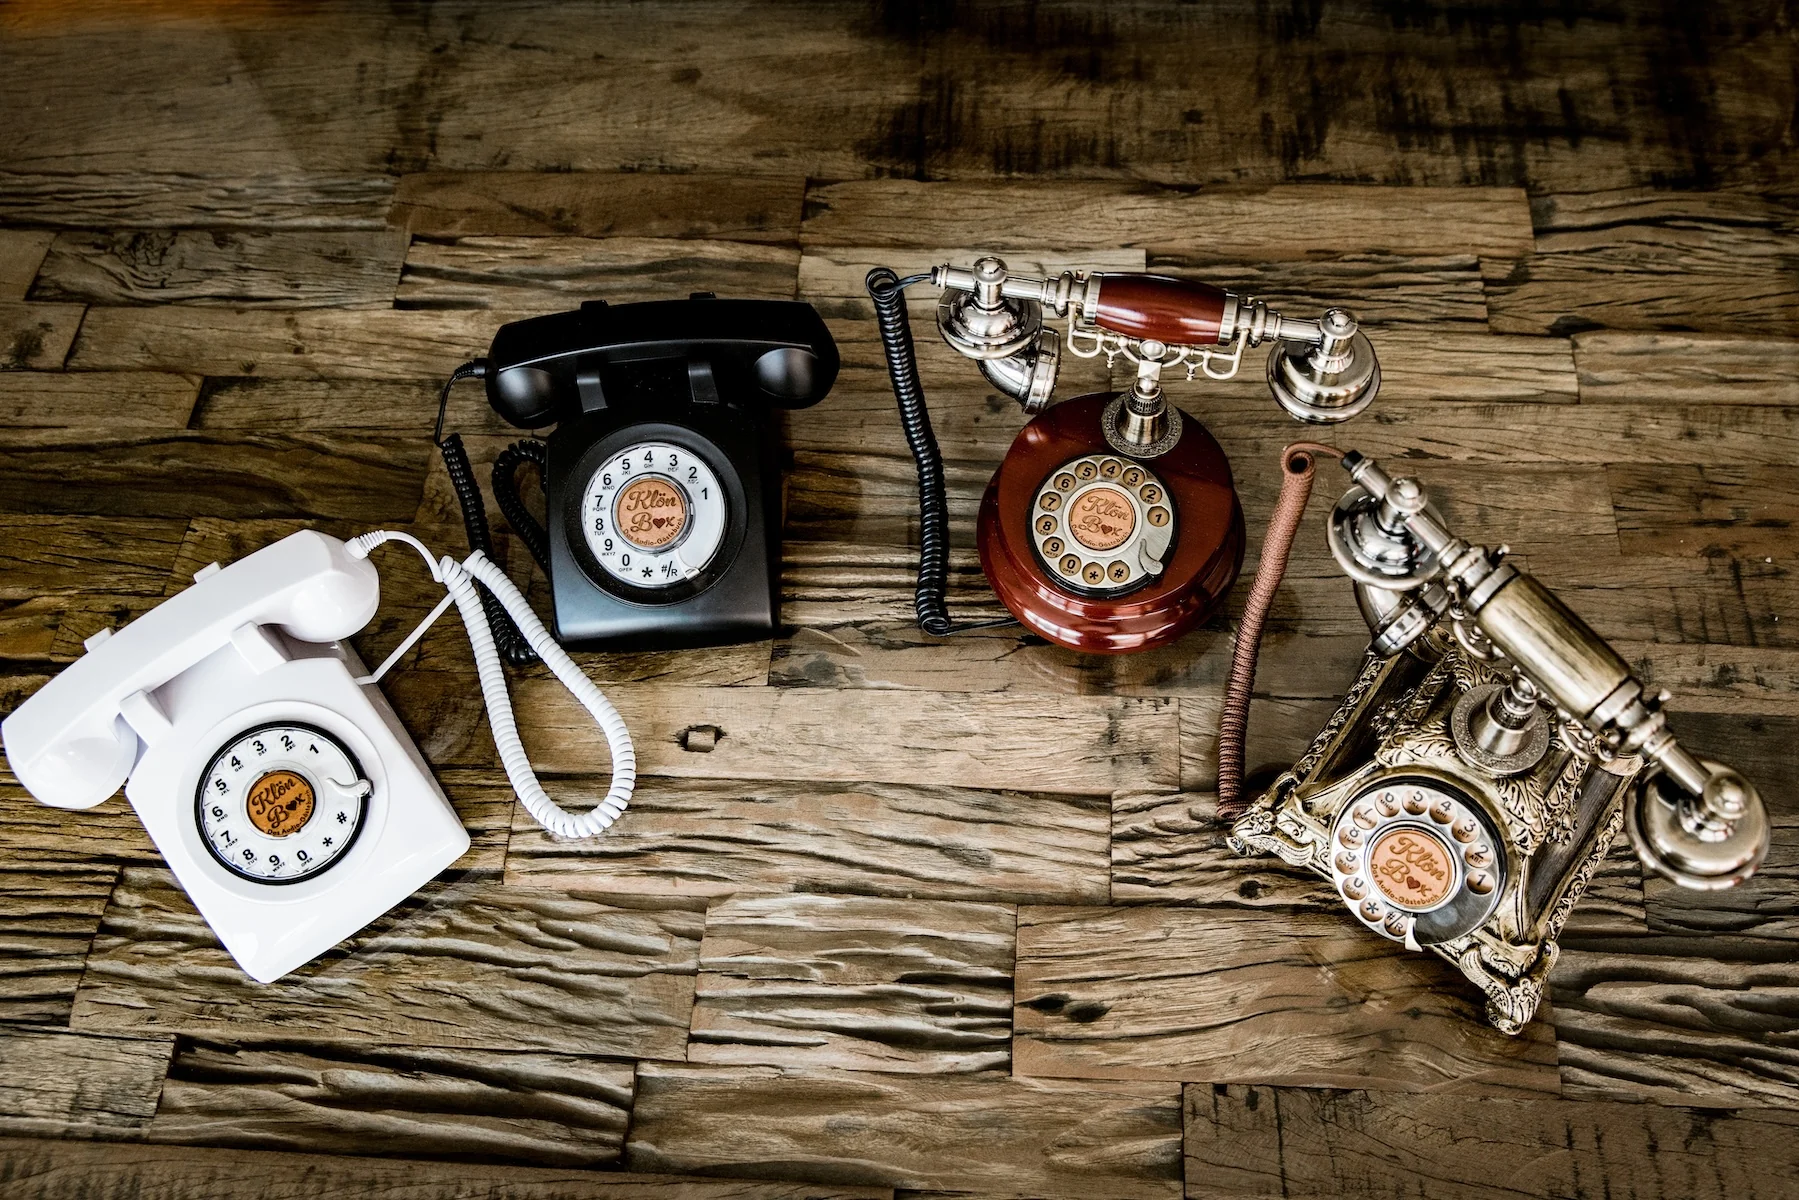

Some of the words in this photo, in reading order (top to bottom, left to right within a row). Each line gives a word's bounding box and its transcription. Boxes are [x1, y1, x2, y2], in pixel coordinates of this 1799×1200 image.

[644, 450, 653, 463] 4
[670, 454, 678, 466] 3
[622, 458, 630, 470] 5
[1106, 466, 1116, 474] 4
[688, 466, 698, 478] 2
[1082, 467, 1092, 476] 5
[1130, 472, 1138, 482] 3
[603, 474, 612, 486] 6
[1062, 478, 1070, 488] 6
[702, 487, 708, 500] 1
[1146, 490, 1156, 500] 2
[595, 495, 603, 506] 7
[626, 490, 676, 511] Klön
[1048, 497, 1056, 506] 7
[596, 518, 604, 530] 8
[1156, 514, 1162, 523] 1
[1042, 521, 1052, 530] 8
[604, 538, 612, 551] 9
[1050, 542, 1060, 552] 9
[622, 554, 630, 566] 0
[1067, 560, 1076, 570] 0
[1114, 568, 1124, 578] #
[252, 740, 264, 752] 3
[280, 735, 292, 748] 2
[310, 744, 319, 754] 1
[231, 756, 241, 767] 4
[215, 778, 226, 791] 5
[252, 778, 296, 815] Klön
[212, 806, 223, 818] 6
[1440, 800, 1452, 812] 4
[336, 812, 347, 824] #
[1464, 819, 1476, 832] 3
[220, 830, 230, 842] 7
[242, 848, 254, 860] 8
[296, 850, 308, 862] 0
[1390, 836, 1445, 880] Klön
[1474, 844, 1488, 860] 2
[268, 855, 280, 866] 9
[1477, 874, 1486, 886] 1
